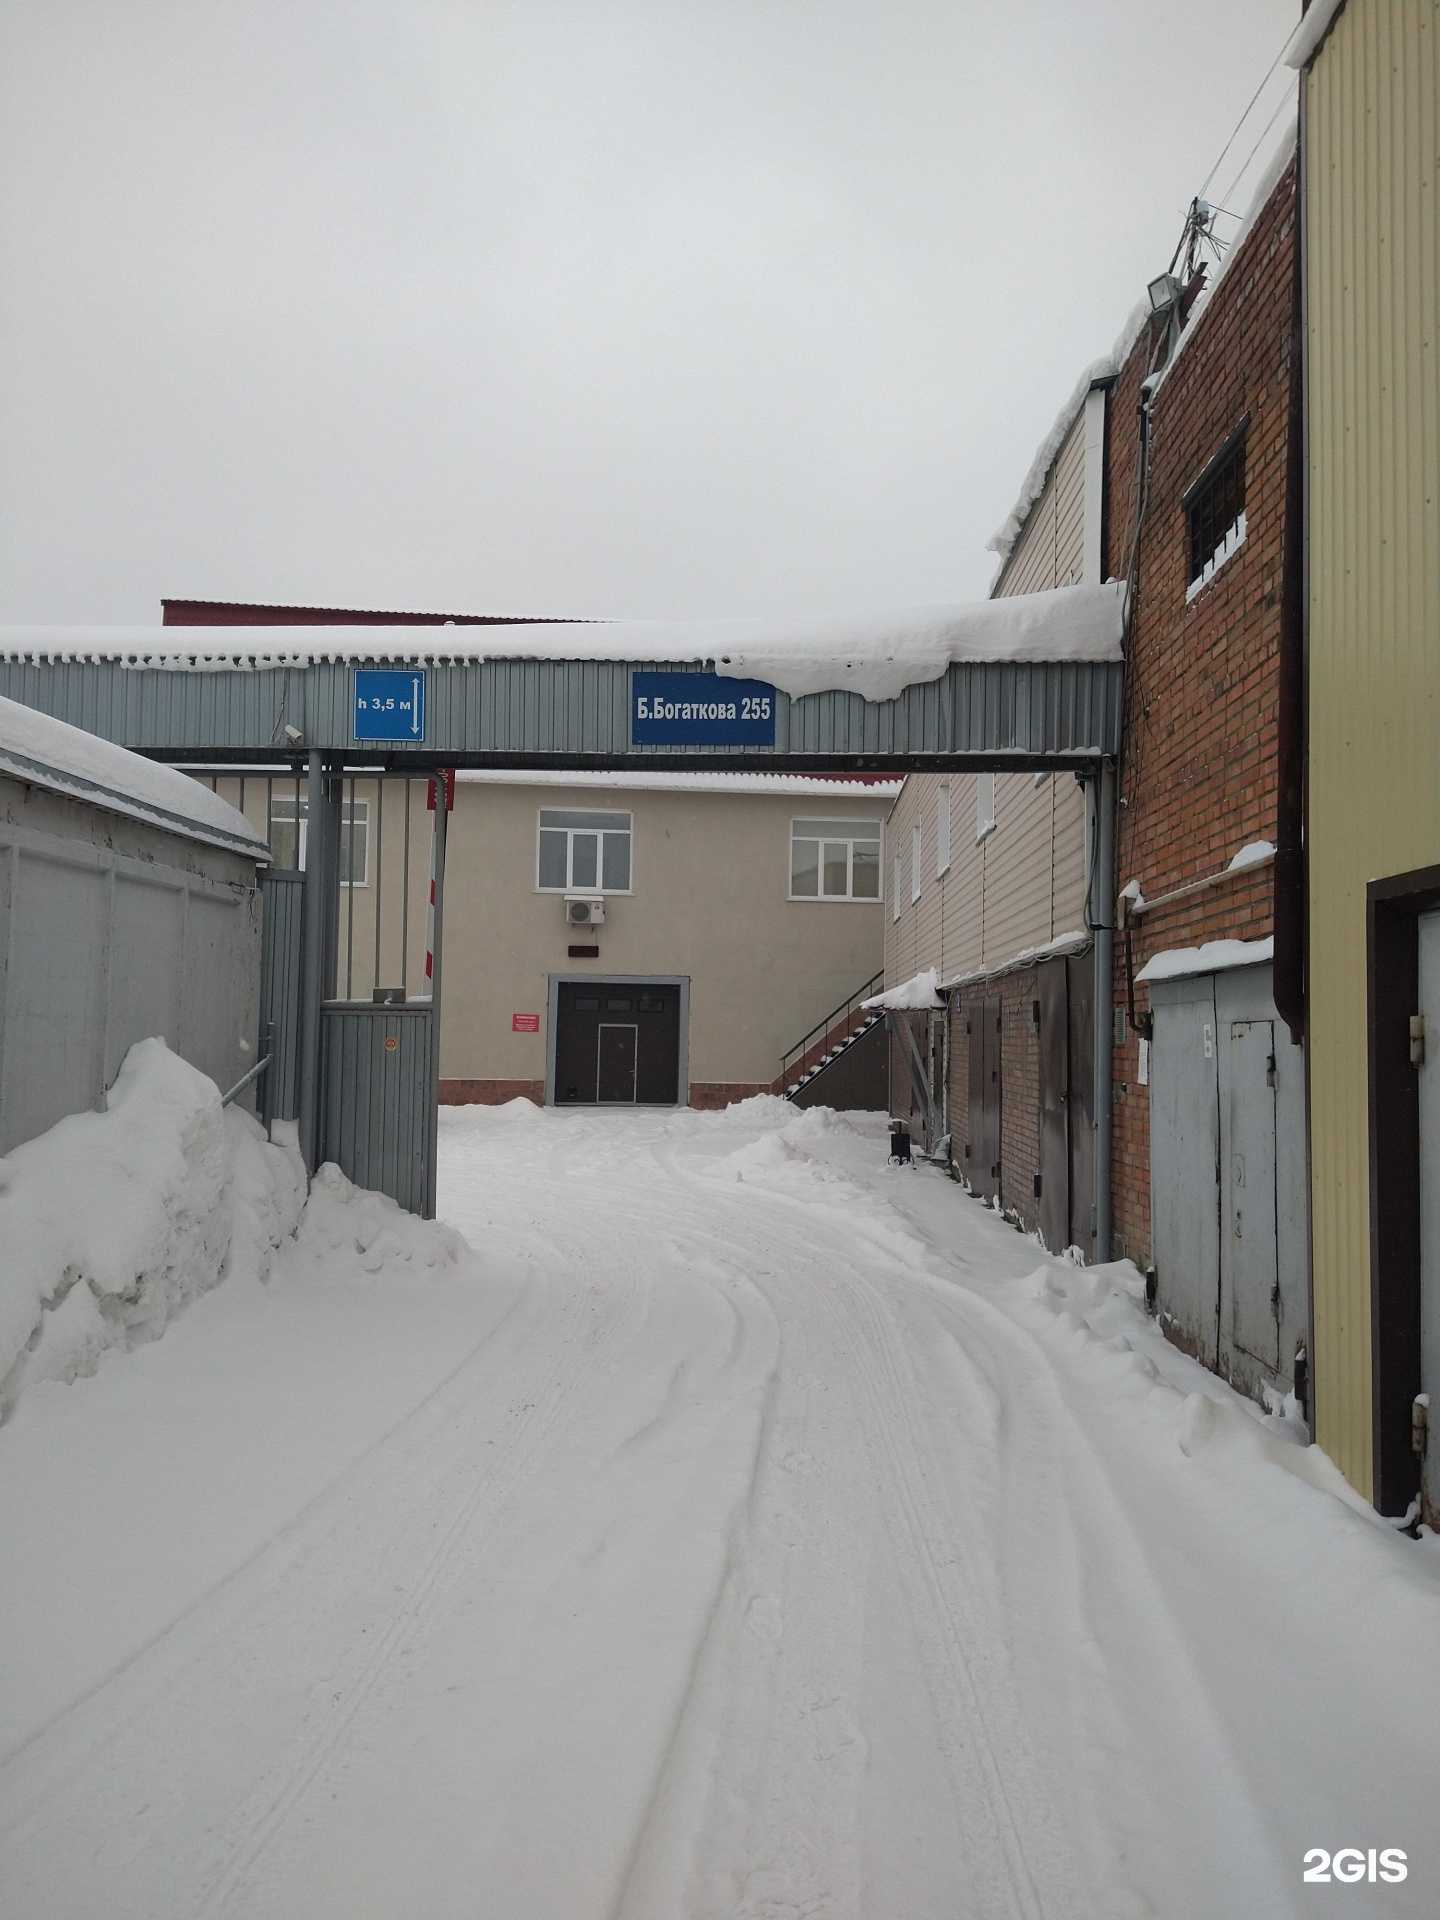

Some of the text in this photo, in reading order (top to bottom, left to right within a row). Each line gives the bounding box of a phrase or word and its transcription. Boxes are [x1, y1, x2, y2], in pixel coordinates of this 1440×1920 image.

[358, 698, 411, 712] h 3,5 м
[637, 697, 770, 720] Б.Богаткова 255
